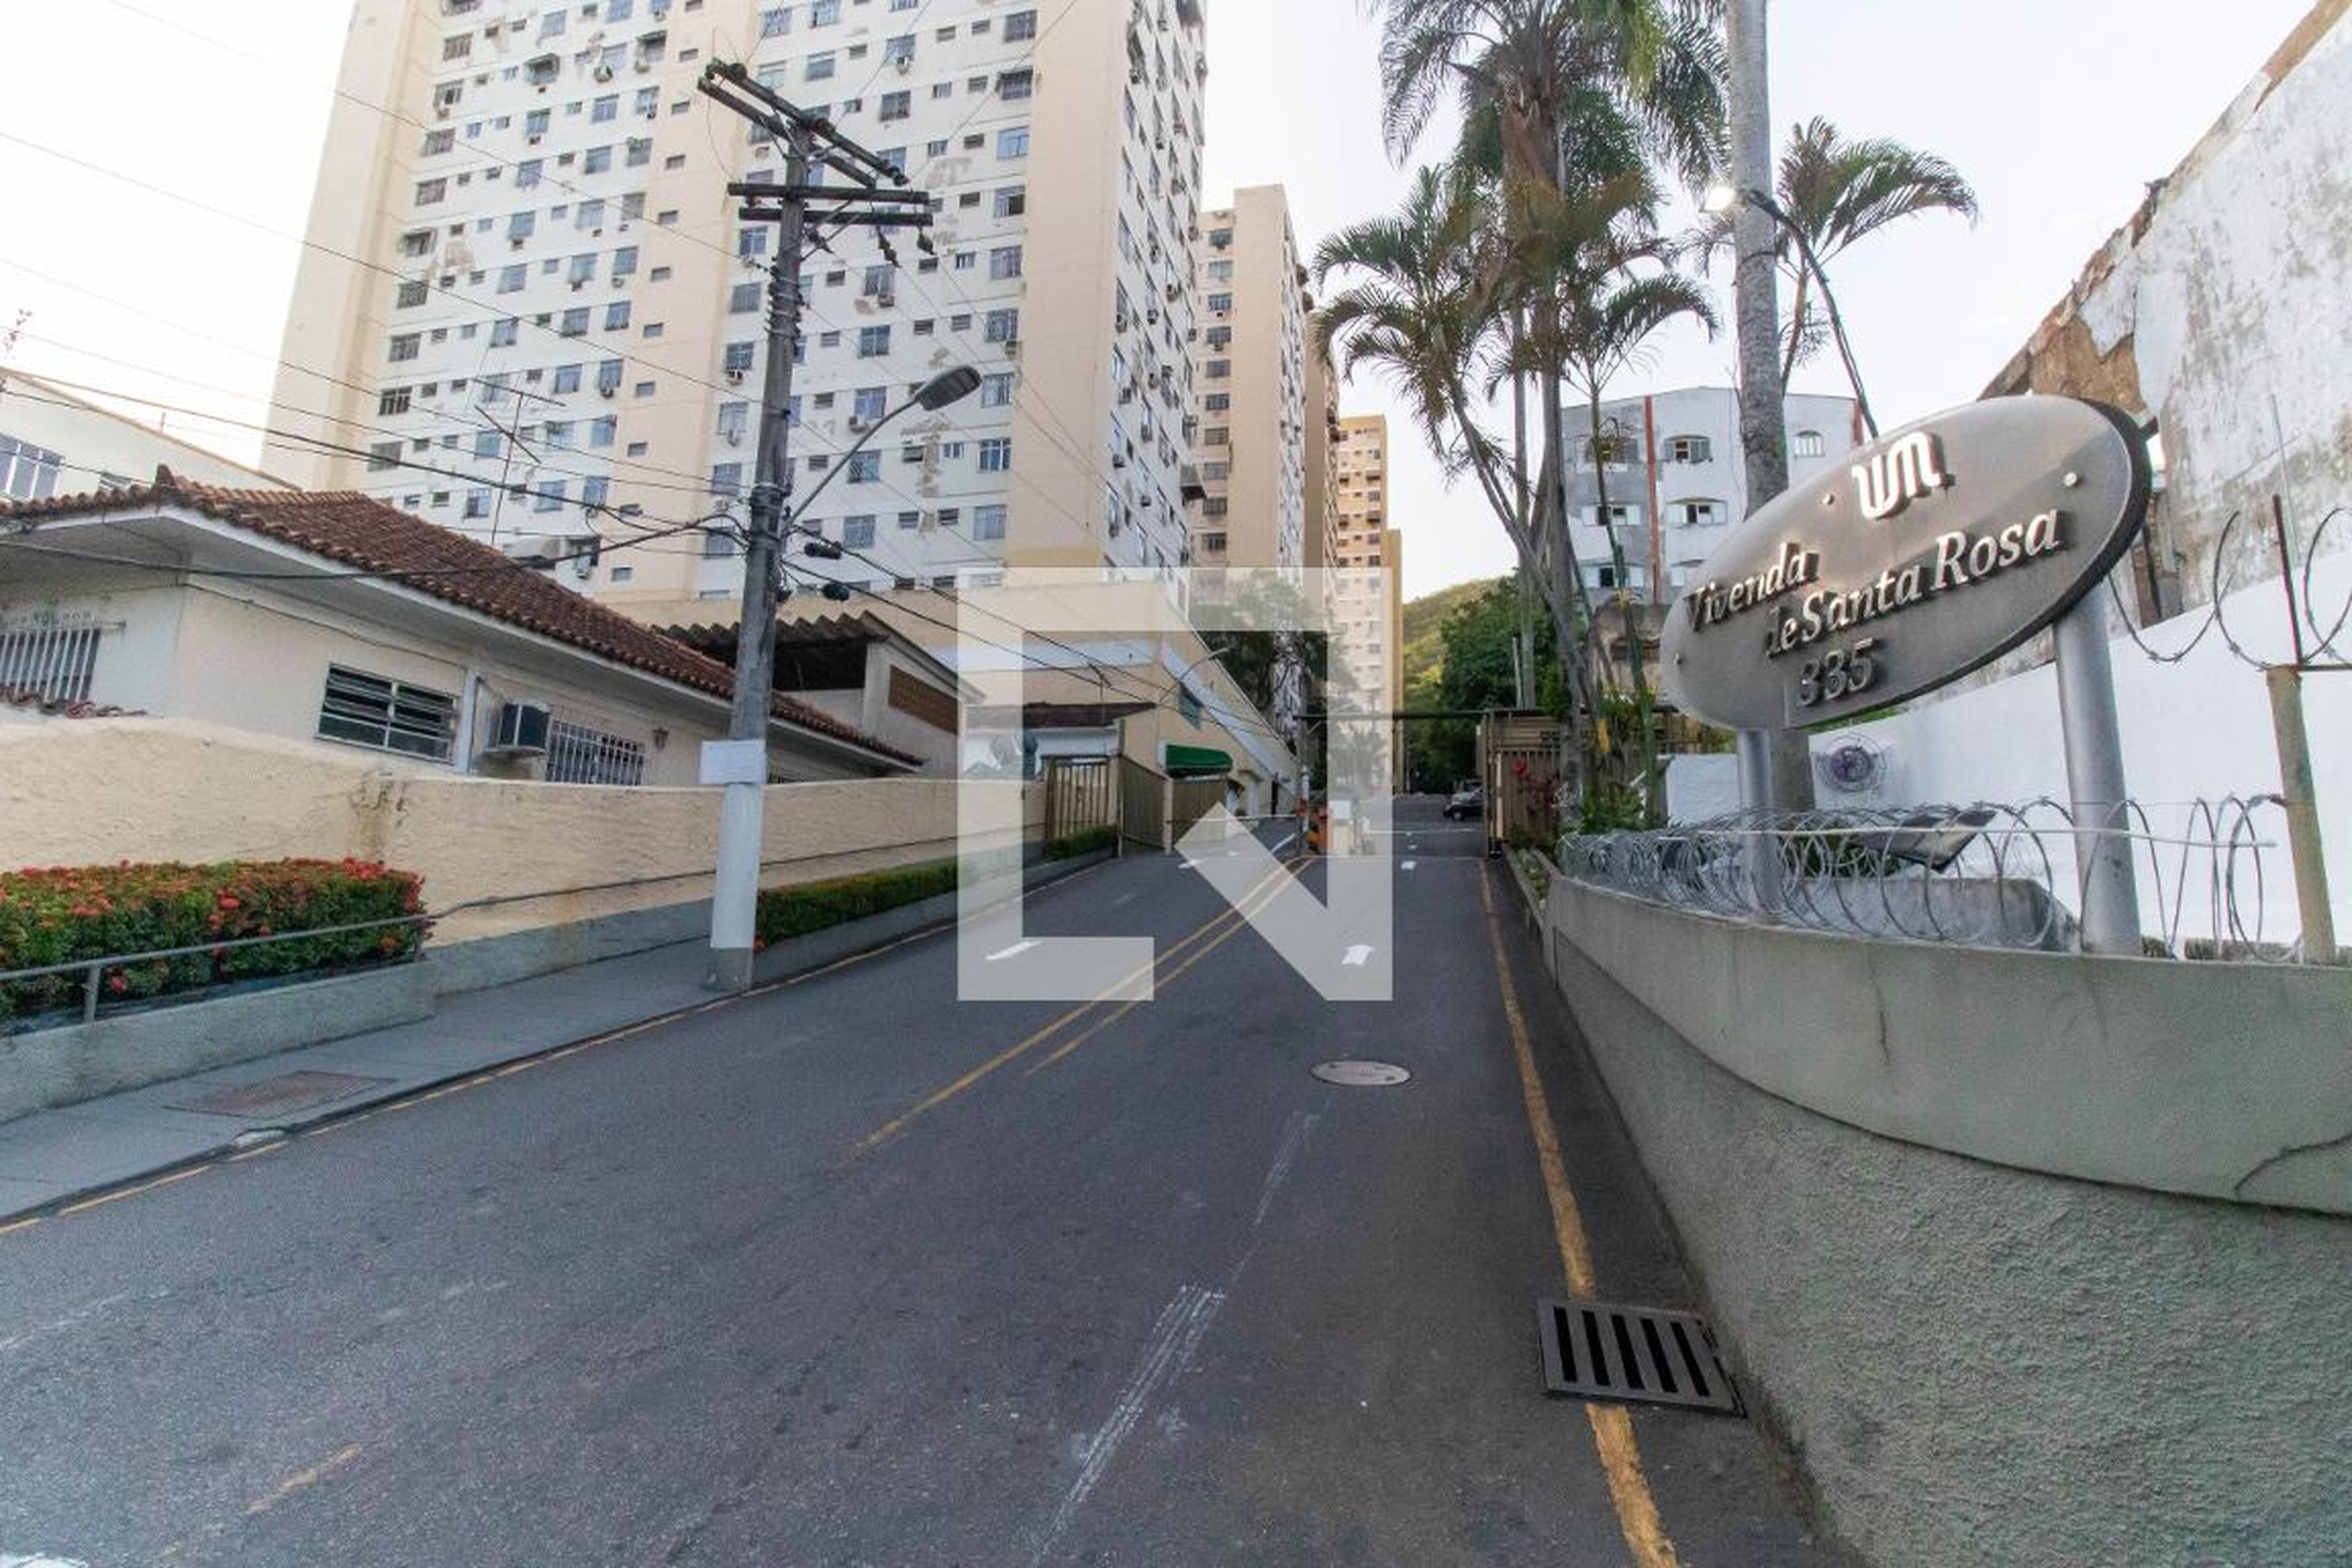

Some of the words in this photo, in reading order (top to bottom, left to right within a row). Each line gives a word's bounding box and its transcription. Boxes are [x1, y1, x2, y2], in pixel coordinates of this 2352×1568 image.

[1683, 542, 1811, 633] Vivenda
[1802, 565, 1923, 642] Santa
[1930, 509, 2059, 591] Rosa
[1796, 637, 1876, 706] 335
